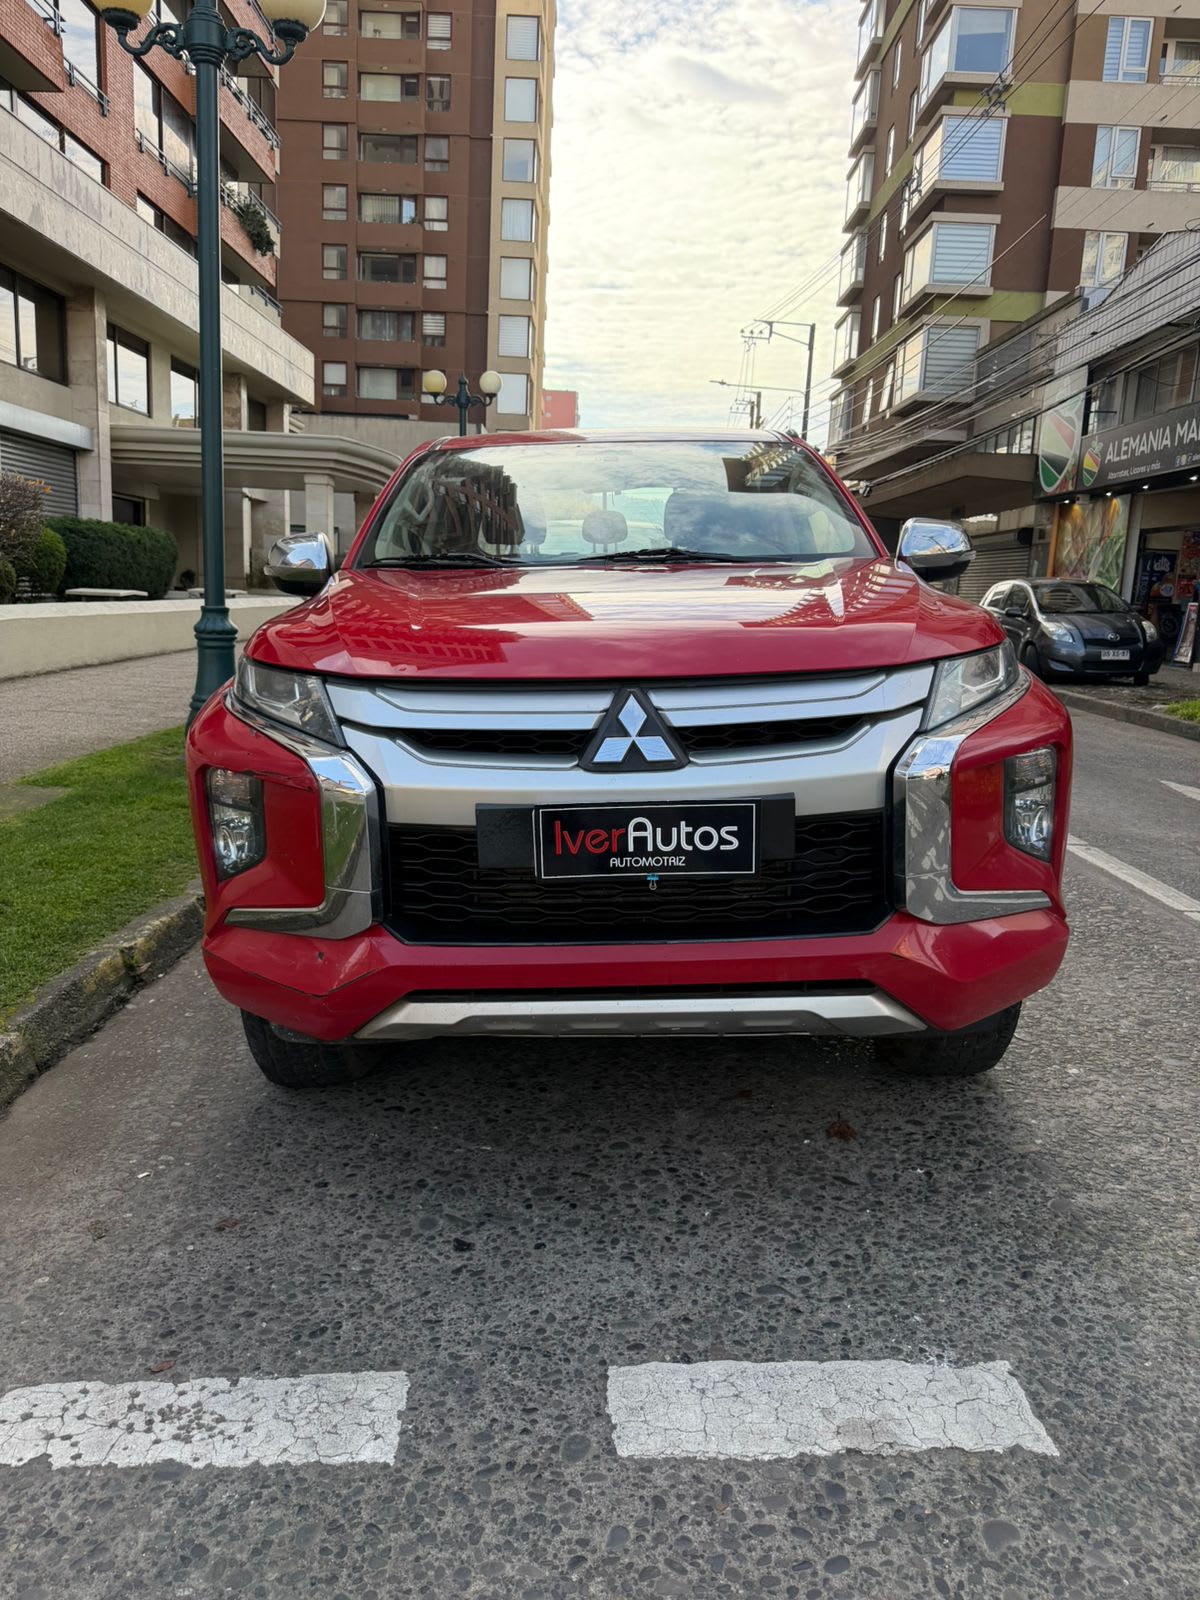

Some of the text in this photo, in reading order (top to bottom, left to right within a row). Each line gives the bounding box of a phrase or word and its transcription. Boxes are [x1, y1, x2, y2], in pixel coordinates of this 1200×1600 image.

[1105, 425, 1171, 464] ALEMANIA
[553, 816, 740, 855] IverAutos
[609, 855, 687, 869] AUTOMOTRIZ
